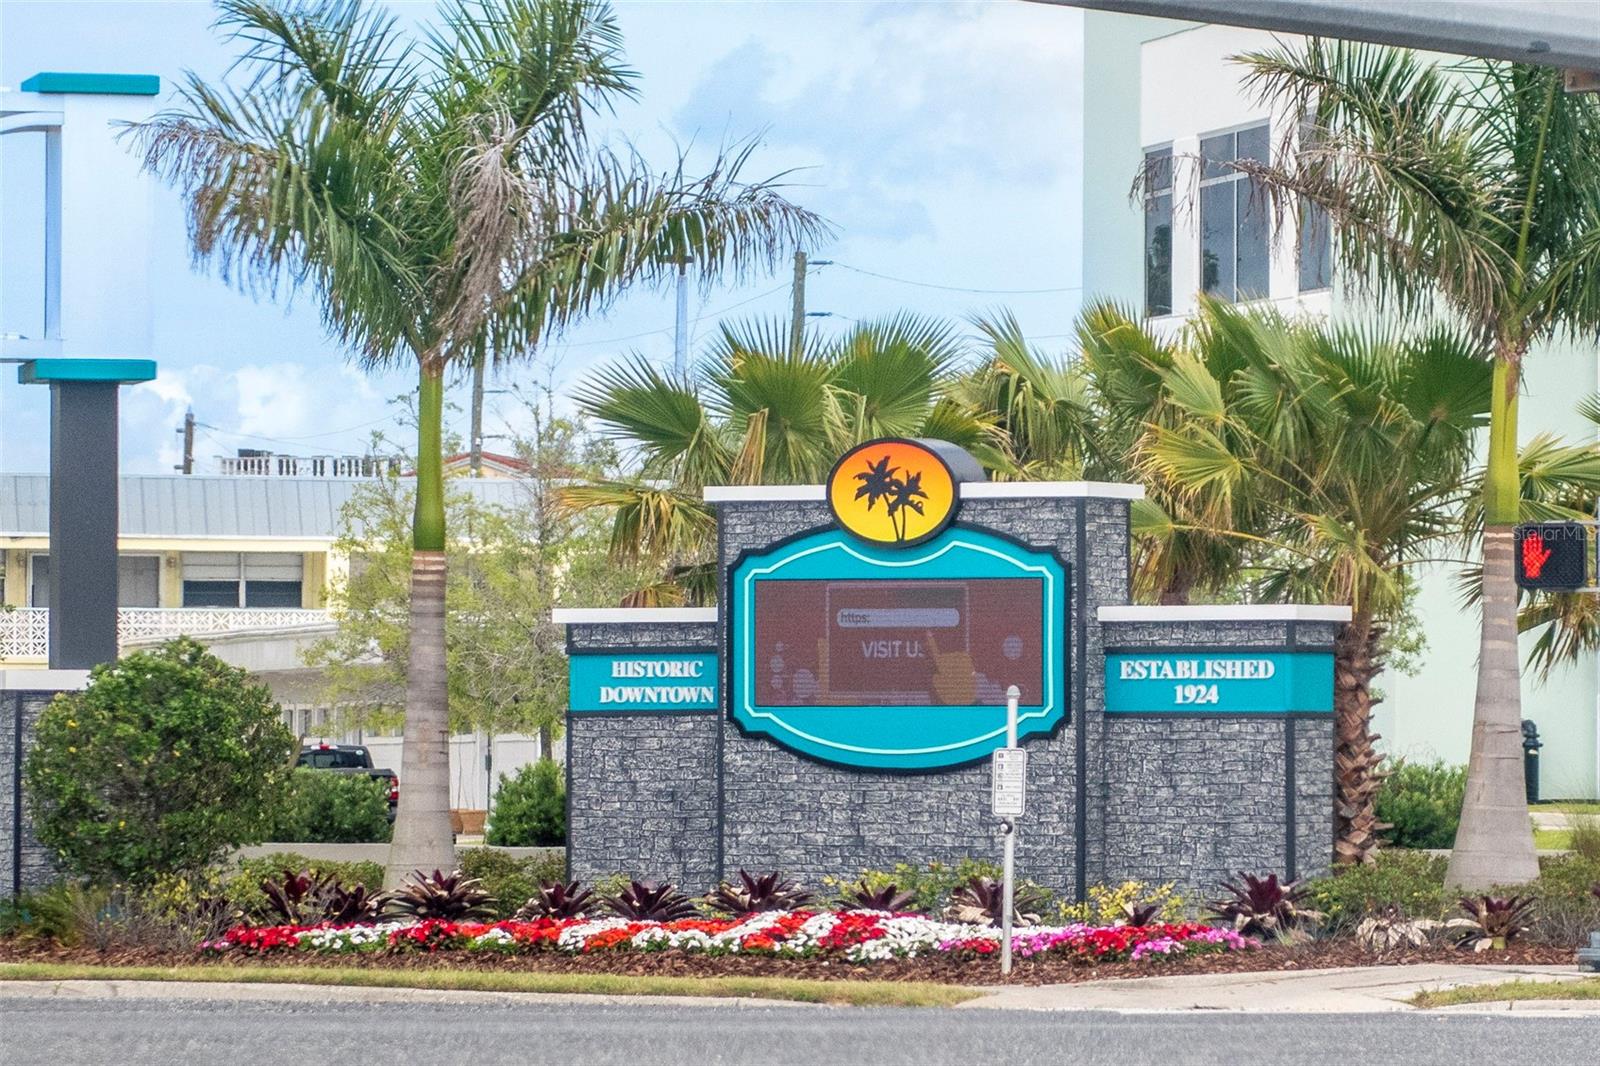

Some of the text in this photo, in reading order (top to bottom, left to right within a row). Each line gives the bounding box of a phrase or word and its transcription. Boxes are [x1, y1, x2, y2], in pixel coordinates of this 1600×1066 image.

[861, 640, 902, 658] VISIT
[611, 660, 704, 678] HISTORIC
[1119, 659, 1276, 680] ESTABLISHED
[599, 686, 715, 704] DOWNTOWN
[1174, 684, 1220, 705] 1924
